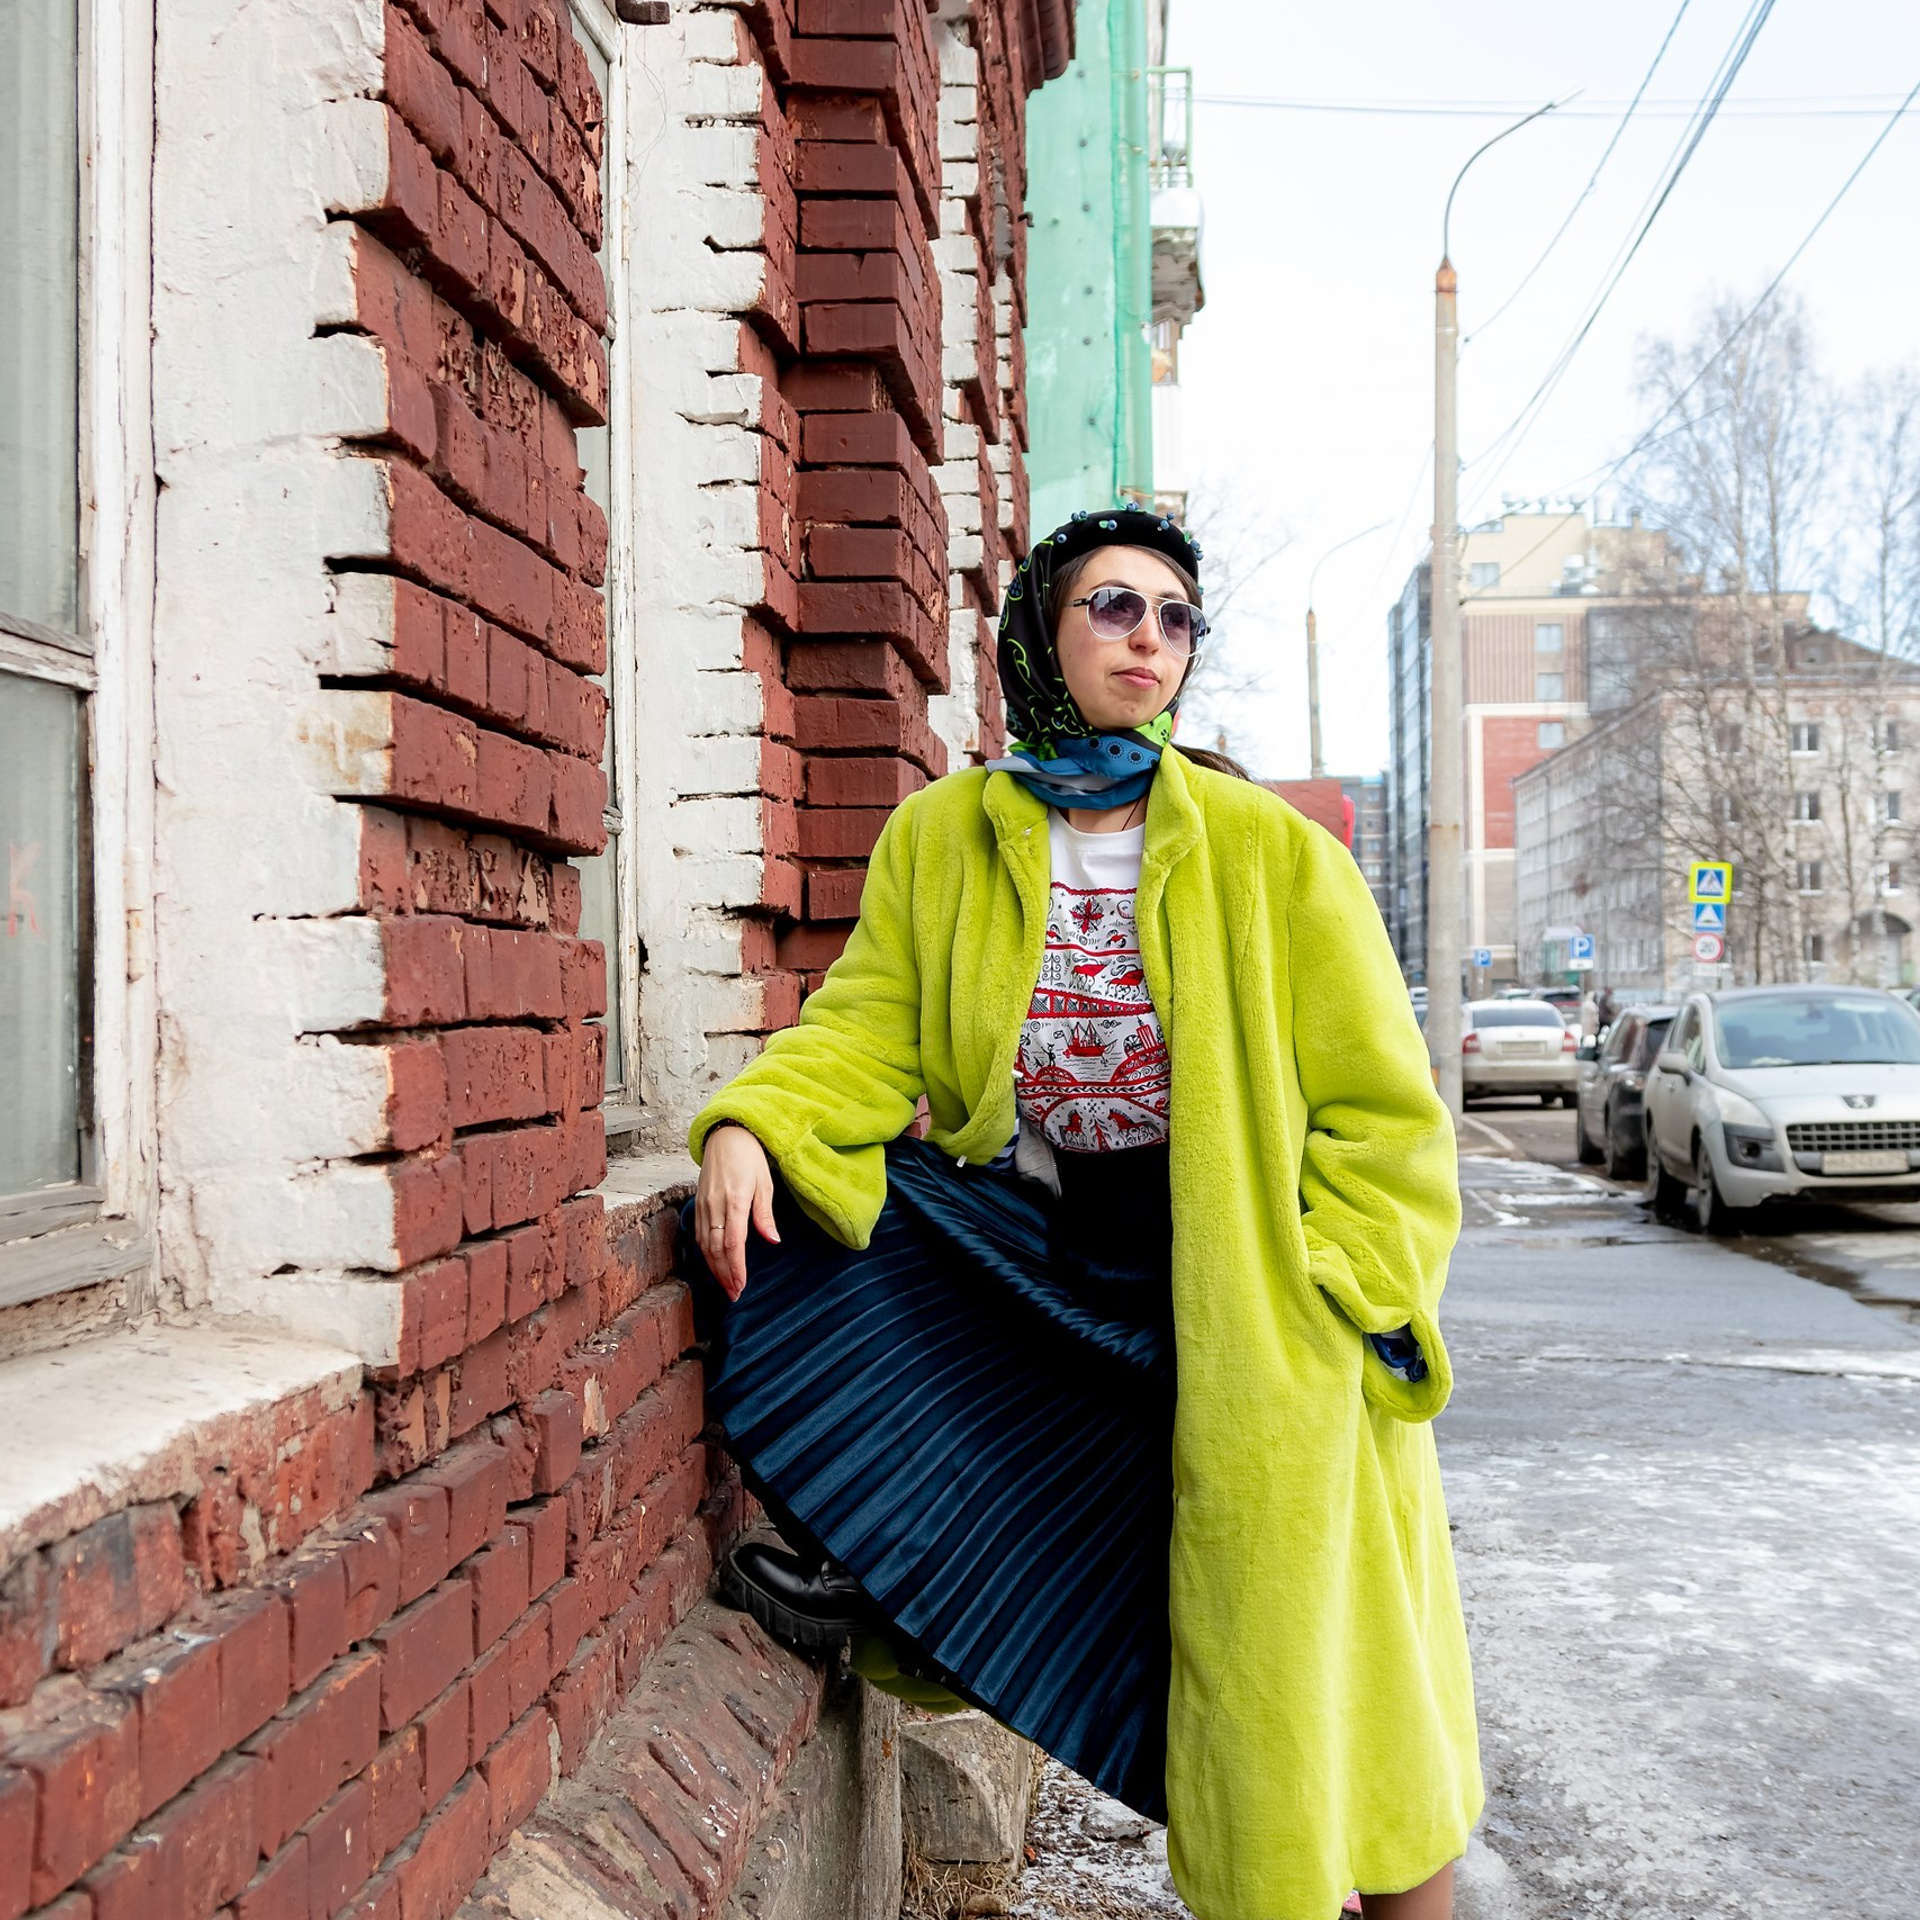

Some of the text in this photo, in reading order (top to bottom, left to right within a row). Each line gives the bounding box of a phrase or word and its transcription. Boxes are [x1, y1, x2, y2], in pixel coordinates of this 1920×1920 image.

[1575, 937, 1590, 957] P
[1700, 941, 1715, 953] 20
[1477, 950, 1489, 965] P
